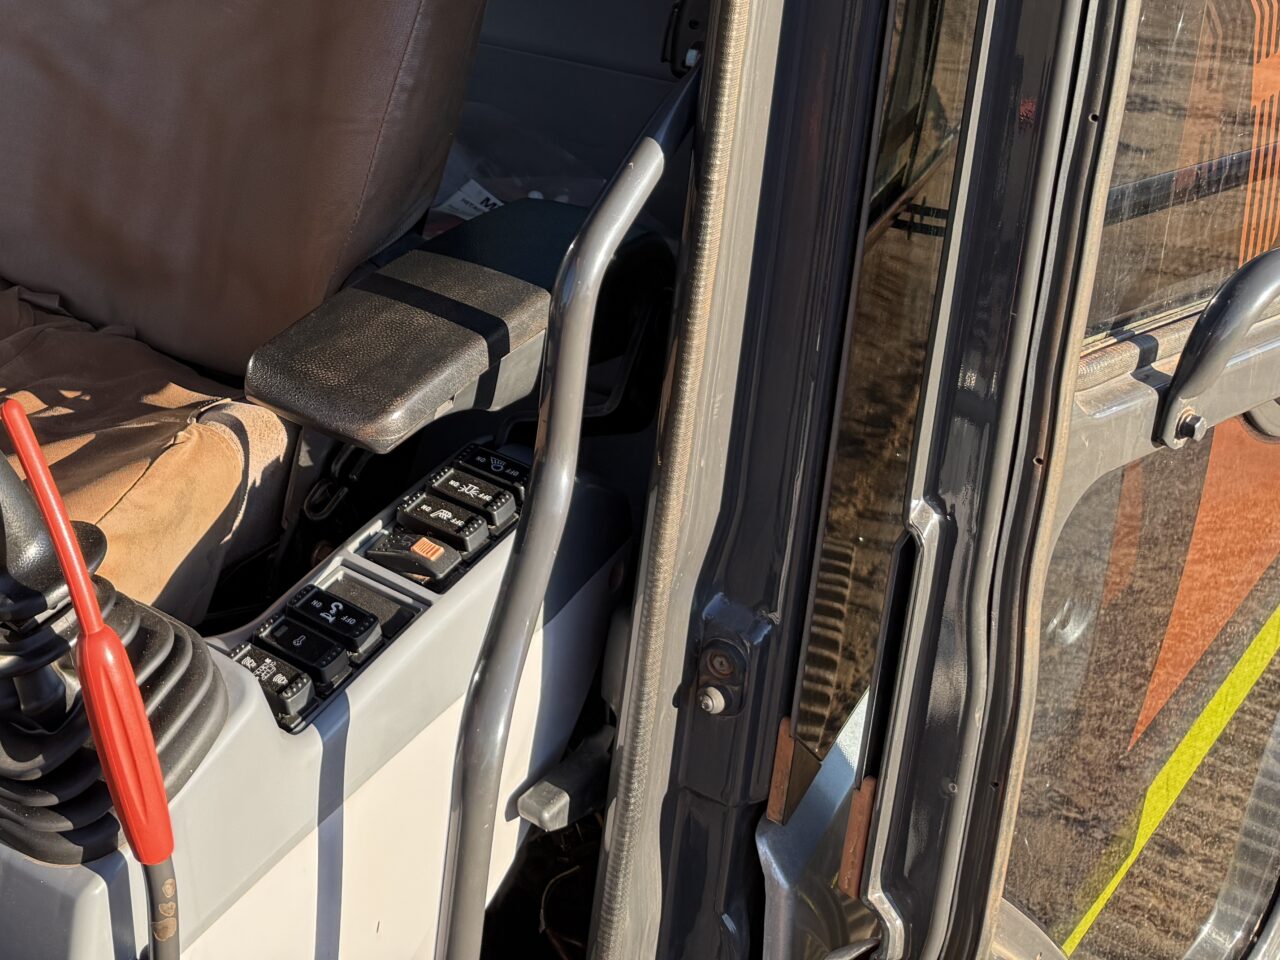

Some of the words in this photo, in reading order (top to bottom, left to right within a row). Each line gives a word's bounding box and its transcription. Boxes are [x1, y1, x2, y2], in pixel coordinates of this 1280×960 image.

[448, 479, 460, 487] ON
[477, 492, 493, 502] OFF
[420, 504, 432, 512] ON
[450, 518, 465, 526] OFF
[310, 599, 323, 608] ON
[340, 615, 357, 625] OFF
